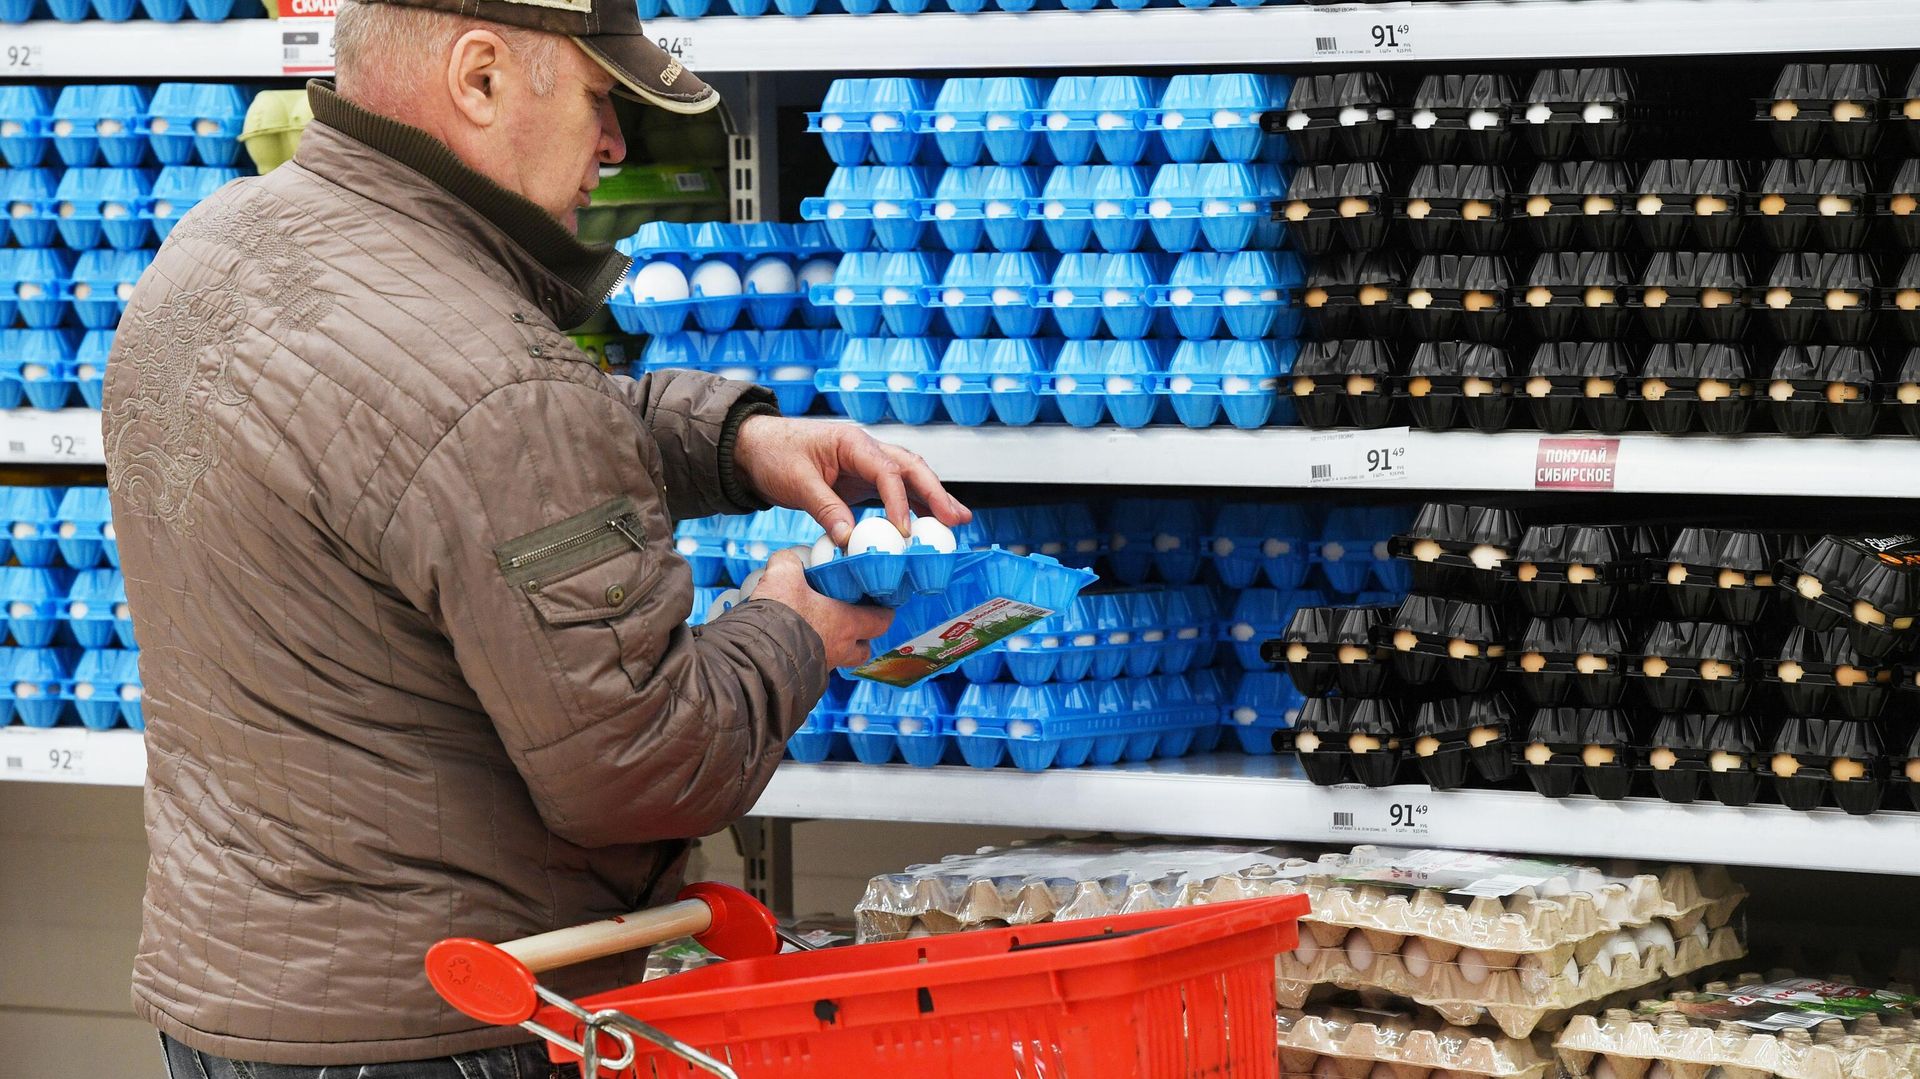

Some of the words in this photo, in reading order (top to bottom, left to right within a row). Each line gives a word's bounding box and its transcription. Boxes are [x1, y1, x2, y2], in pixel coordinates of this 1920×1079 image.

[1371, 25, 1398, 47] 91
[1397, 25, 1409, 34] 49
[8, 46, 30, 66] 92
[51, 435, 76, 455] 92
[1367, 449, 1392, 472] 91
[1392, 447, 1405, 457] 49
[1546, 447, 1607, 464] ПОКУПАЙ
[1537, 467, 1612, 483] СИБИРСКОЕ
[49, 749, 72, 769] 92
[1390, 804, 1415, 827] 91
[1416, 805, 1428, 814] 49
